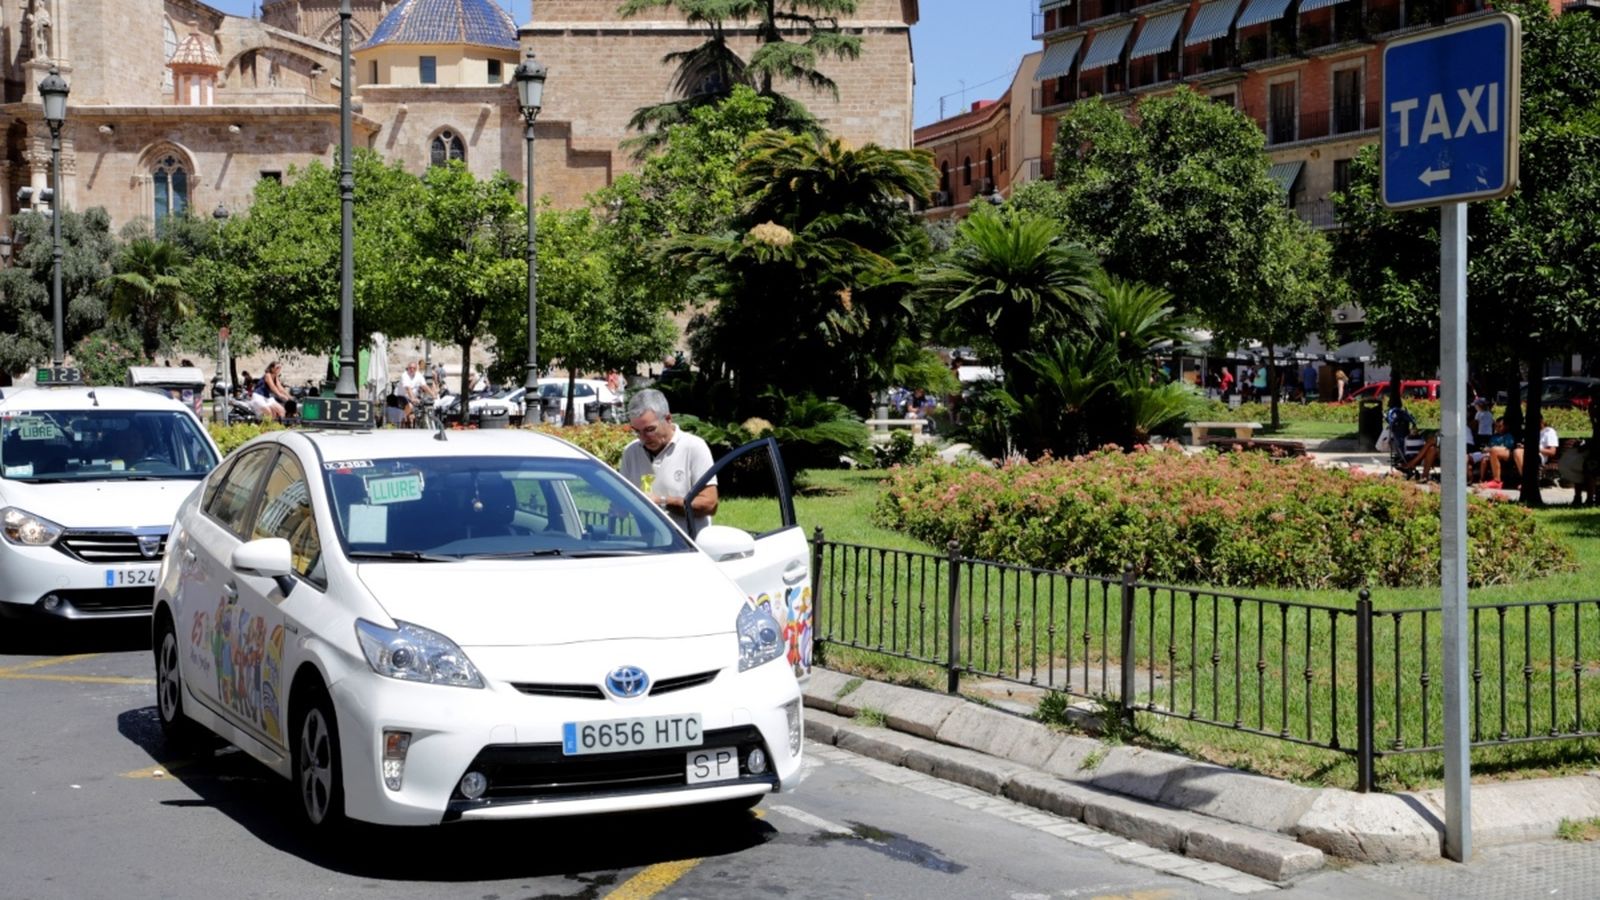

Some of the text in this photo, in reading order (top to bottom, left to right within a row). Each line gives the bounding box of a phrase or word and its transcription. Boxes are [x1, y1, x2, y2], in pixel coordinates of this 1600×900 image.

[1391, 82, 1499, 147] TAXI
[51, 368, 81, 381] 123
[324, 400, 370, 421] 123
[22, 425, 54, 438] LIBRE
[372, 479, 418, 501] LLIURE
[118, 569, 156, 584] 1524
[581, 717, 698, 749] 6656 HTC
[693, 751, 731, 778] SP
